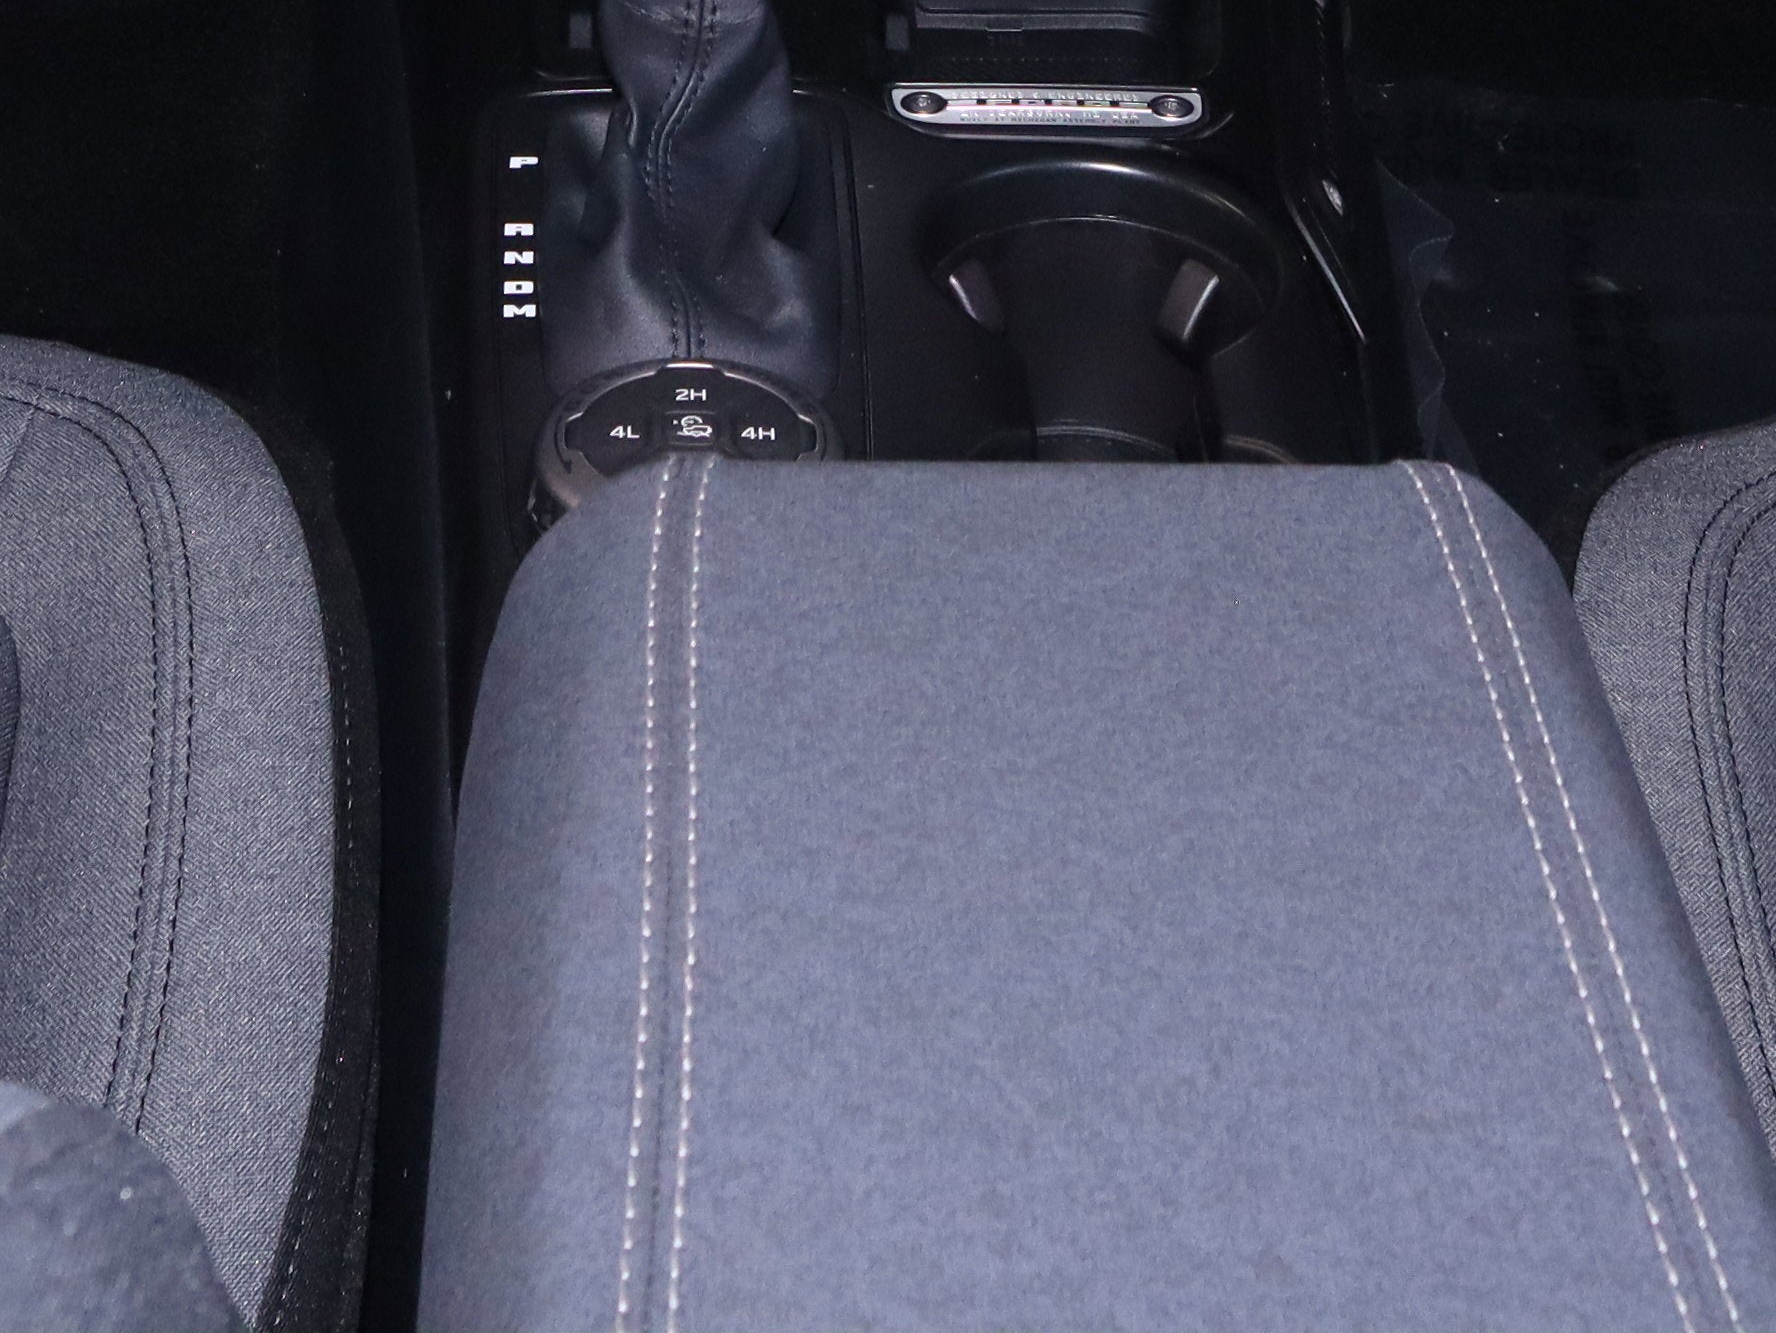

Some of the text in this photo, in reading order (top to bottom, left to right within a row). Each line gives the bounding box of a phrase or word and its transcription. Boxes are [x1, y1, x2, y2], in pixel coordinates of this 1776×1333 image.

[509, 157, 539, 168] P
[503, 251, 534, 265] N
[503, 280, 534, 295] D
[503, 303, 537, 318] M
[675, 388, 706, 401] 2H
[610, 425, 640, 439] 4L
[741, 426, 775, 440] 4H
